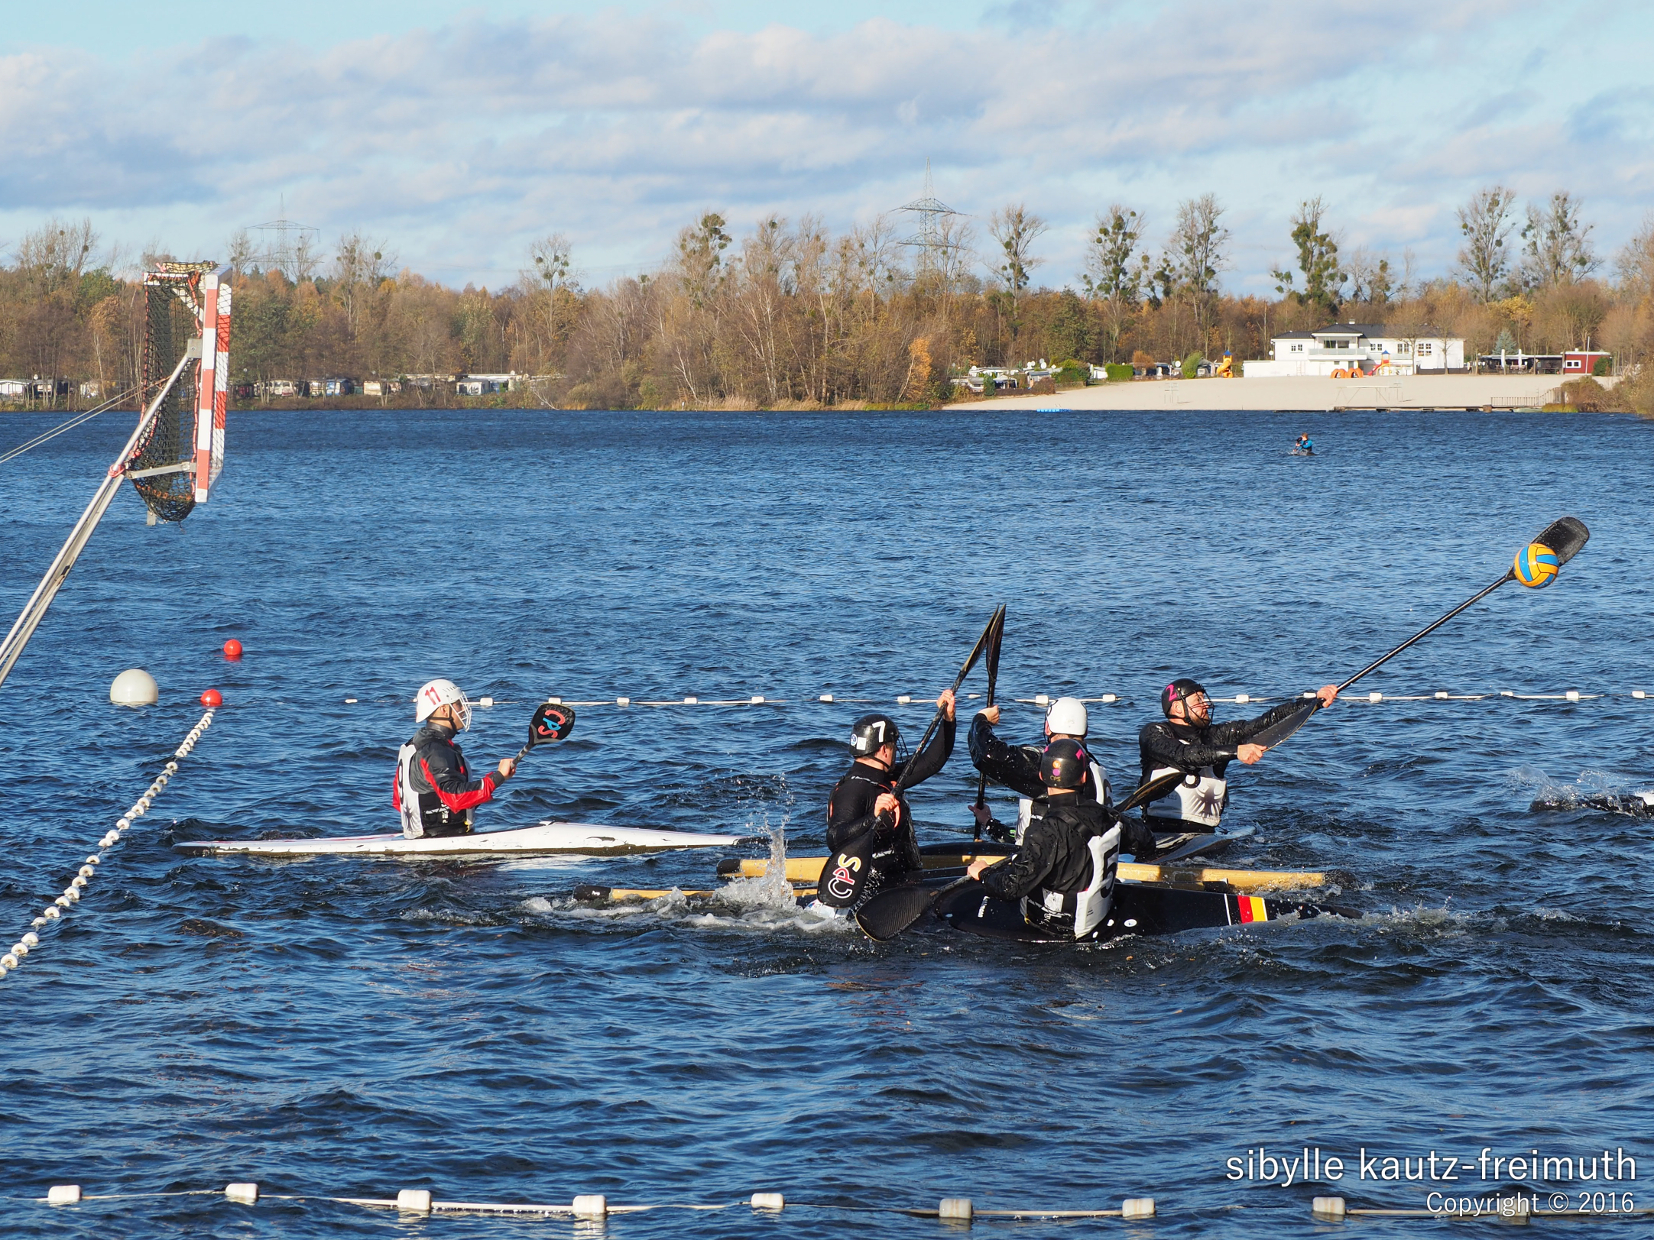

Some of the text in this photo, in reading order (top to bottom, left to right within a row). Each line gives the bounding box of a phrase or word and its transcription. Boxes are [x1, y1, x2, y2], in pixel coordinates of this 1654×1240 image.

[424, 686, 441, 706] 11
[1165, 684, 1178, 702] 2
[537, 709, 566, 739] CPS
[871, 720, 886, 743] 7
[827, 853, 862, 899] CPS
[1100, 841, 1120, 899] 5
